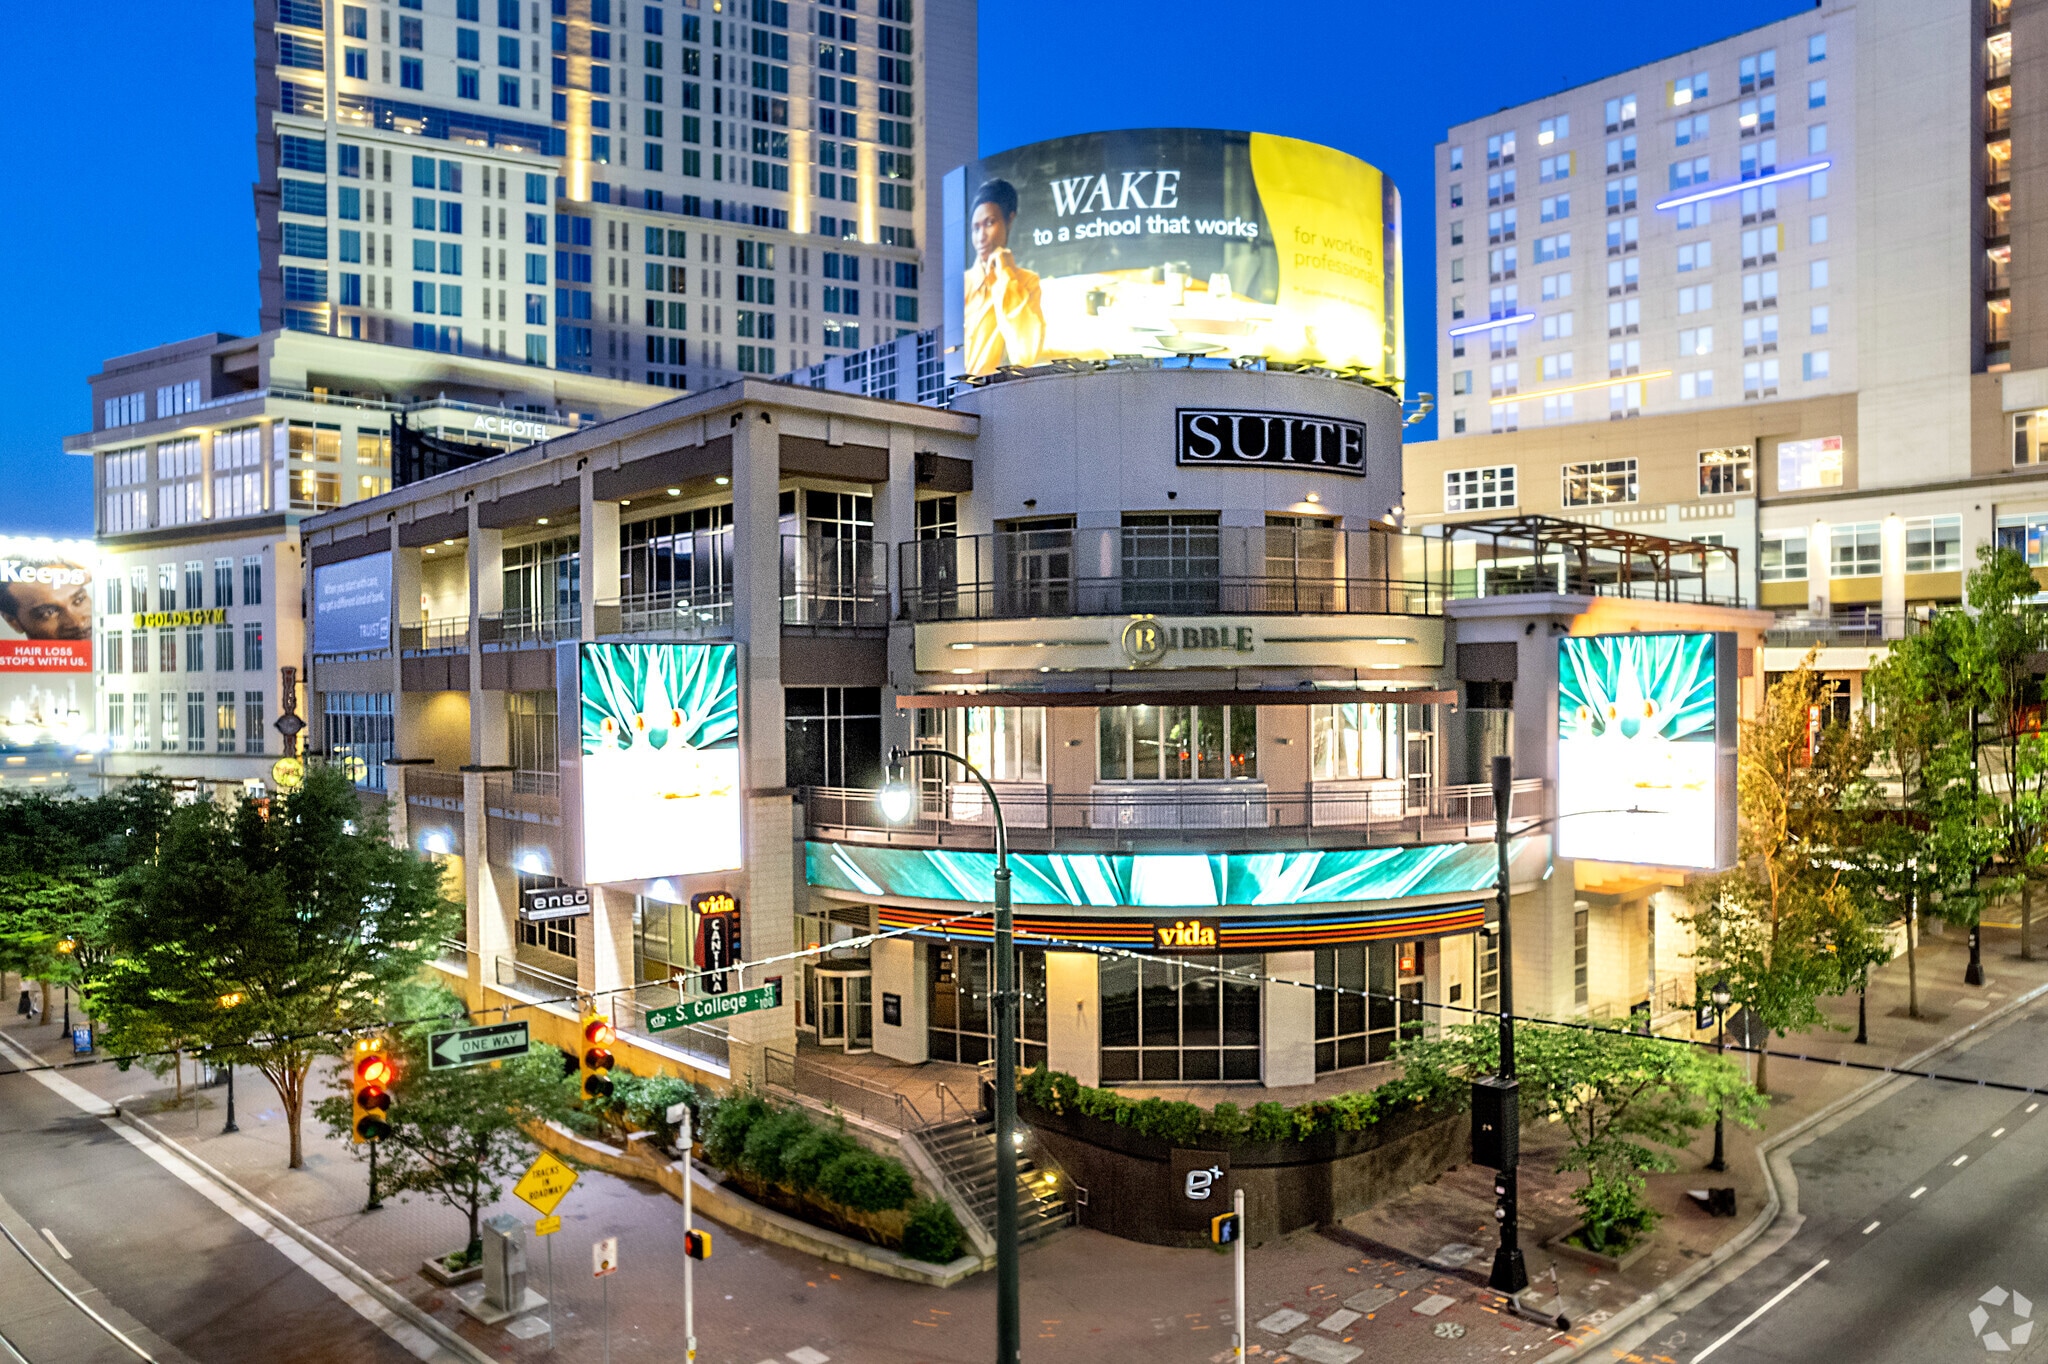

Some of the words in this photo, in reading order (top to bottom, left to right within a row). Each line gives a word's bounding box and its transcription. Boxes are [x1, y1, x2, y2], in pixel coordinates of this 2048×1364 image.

[1049, 171, 1180, 217] WAKE
[1033, 229, 1052, 246] to
[1058, 227, 1069, 241] a
[1075, 216, 1141, 239] school
[1147, 215, 1190, 234] that
[1195, 217, 1258, 238] works
[1294, 226, 1317, 245] for
[1321, 236, 1373, 266] working
[474, 415, 497, 432] AC
[501, 419, 550, 440] HOTEL
[1189, 415, 1363, 468] SUITE
[0, 560, 86, 590] Keeps
[145, 610, 191, 628] GOLD'S
[193, 608, 226, 625] GYM
[0, 657, 35, 666] STOPS
[38, 657, 67, 666] WITH
[70, 657, 87, 666] US.
[15, 647, 41, 655] HAIR
[45, 647, 72, 656] LOSS
[698, 895, 735, 914] vida
[1158, 920, 1216, 945] vida
[711, 919, 722, 992] CANTINA
[675, 1005, 688, 1021] S.
[694, 995, 747, 1014] College
[760, 997, 774, 1009] 100
[462, 1040, 488, 1052] ONE
[492, 1034, 518, 1047] WAY
[532, 1166, 559, 1178] TRACKS
[542, 1178, 550, 1186] IN
[529, 1185, 563, 1200] ROADWAY
